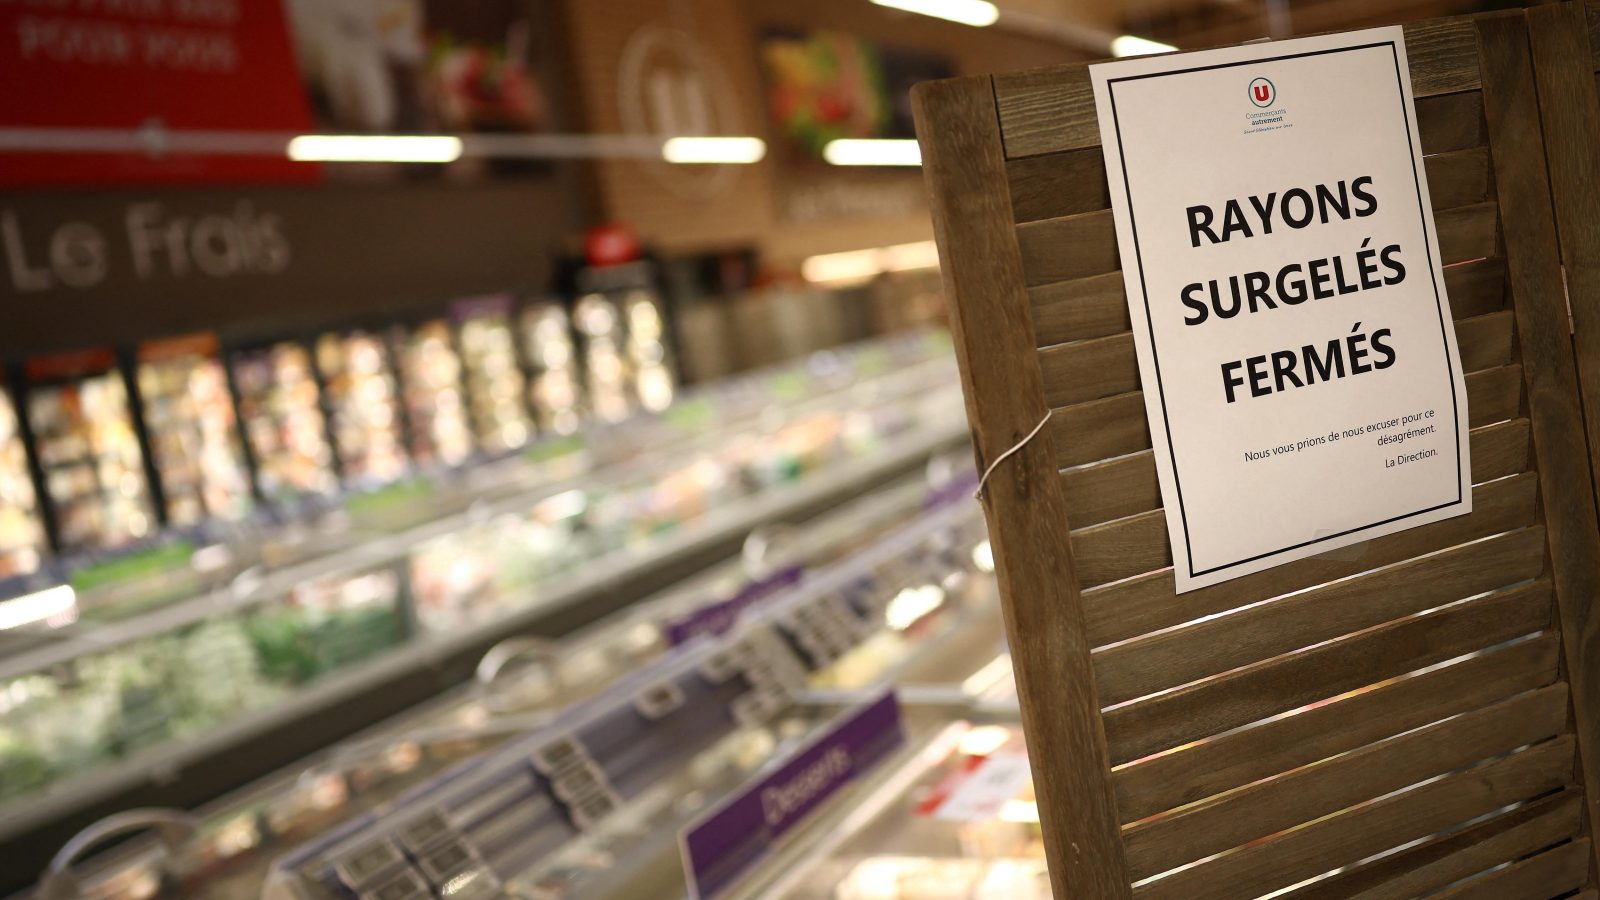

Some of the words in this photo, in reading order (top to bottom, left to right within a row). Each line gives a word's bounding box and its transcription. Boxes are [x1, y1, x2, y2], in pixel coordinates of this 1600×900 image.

[1251, 116, 1284, 126] autrement
[1186, 175, 1378, 248] RAYONS
[2, 207, 107, 290] Le
[124, 198, 290, 282] Frais
[1180, 237, 1407, 326] SURGELÉS
[1221, 321, 1396, 404] FERMÉS
[1244, 451, 1270, 462] Nous
[1272, 444, 1295, 456] vous
[1296, 437, 1326, 452] prions
[1328, 432, 1340, 442] de
[1342, 427, 1364, 439] nous
[1366, 418, 1400, 433] excuser
[1402, 413, 1422, 426] pour
[1424, 408, 1435, 418] ce
[1377, 424, 1437, 446] désagrément.
[1385, 457, 1395, 468] La
[1397, 448, 1438, 465] Direction.
